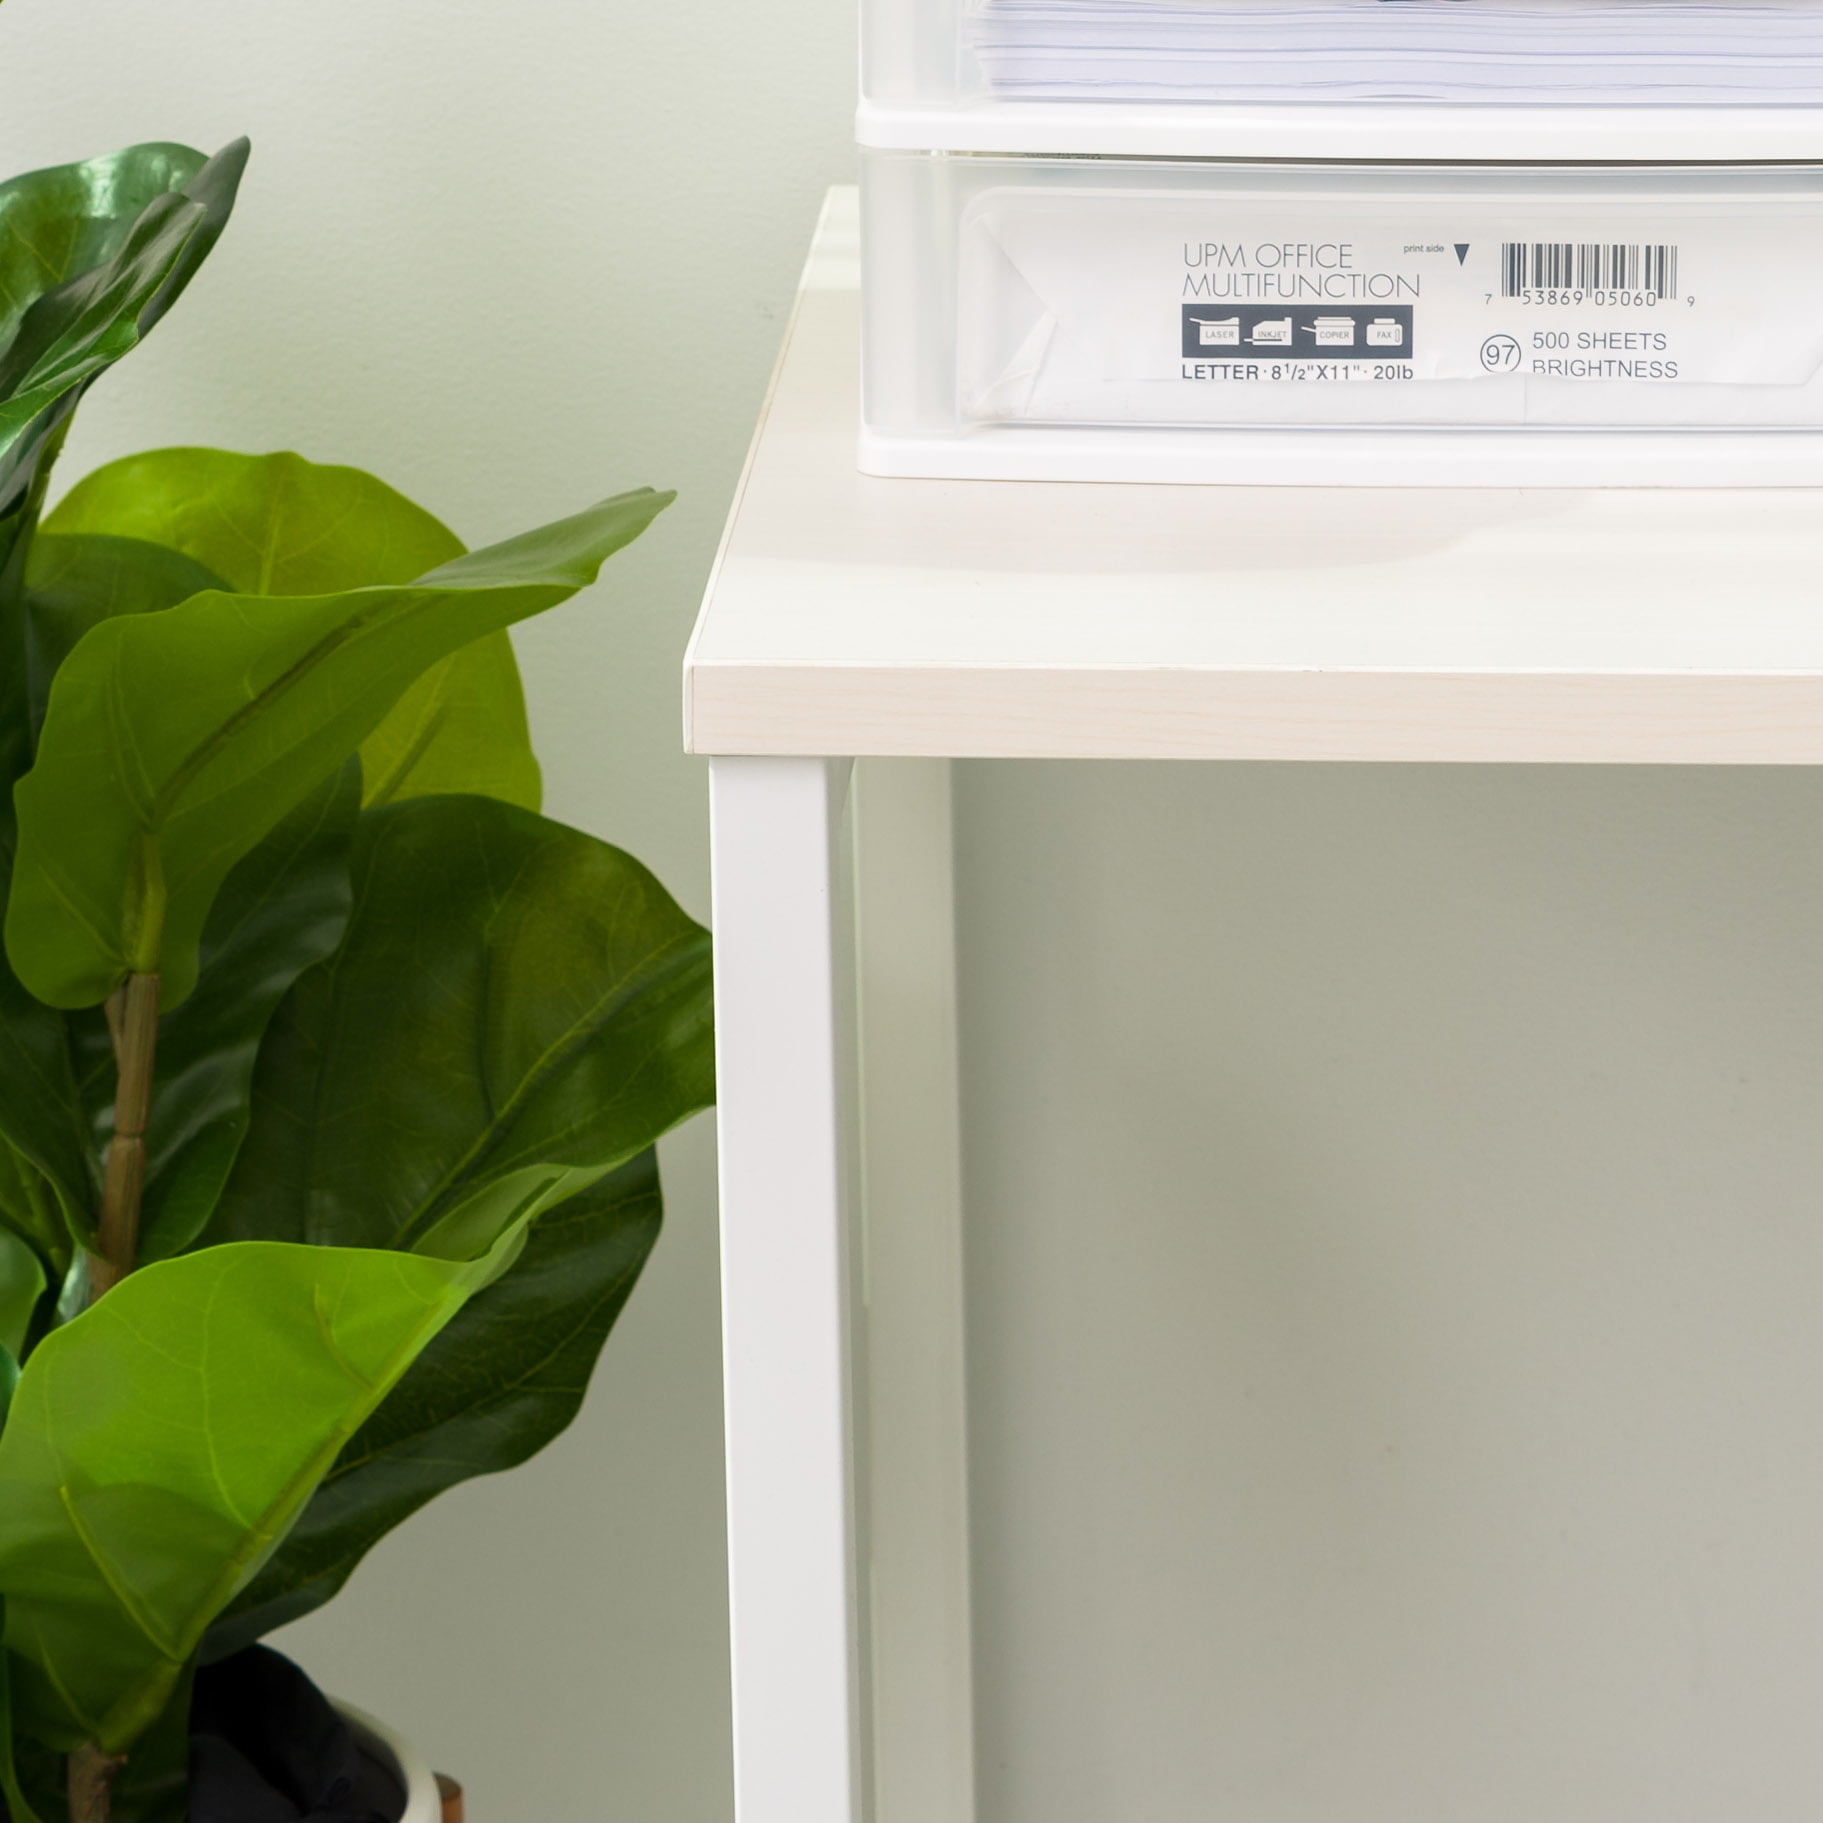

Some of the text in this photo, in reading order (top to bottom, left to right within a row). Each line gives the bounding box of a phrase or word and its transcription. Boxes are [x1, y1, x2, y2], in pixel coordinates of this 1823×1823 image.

[1183, 242, 1353, 269] UPM OFFICE
[1403, 243, 1445, 254] print side
[1182, 272, 1421, 298] MULTIFUNCTION
[1484, 289, 1696, 308] 7 53869 05060 9
[1204, 330, 1392, 340] LASER INKJET COPIER FAX
[1532, 331, 1668, 351] 500 SHEETS
[1485, 343, 1516, 366] 97
[1181, 364, 1260, 381] LETTER
[1373, 364, 1414, 381] 20lb
[1532, 358, 1679, 379] BRIGHTNESS
